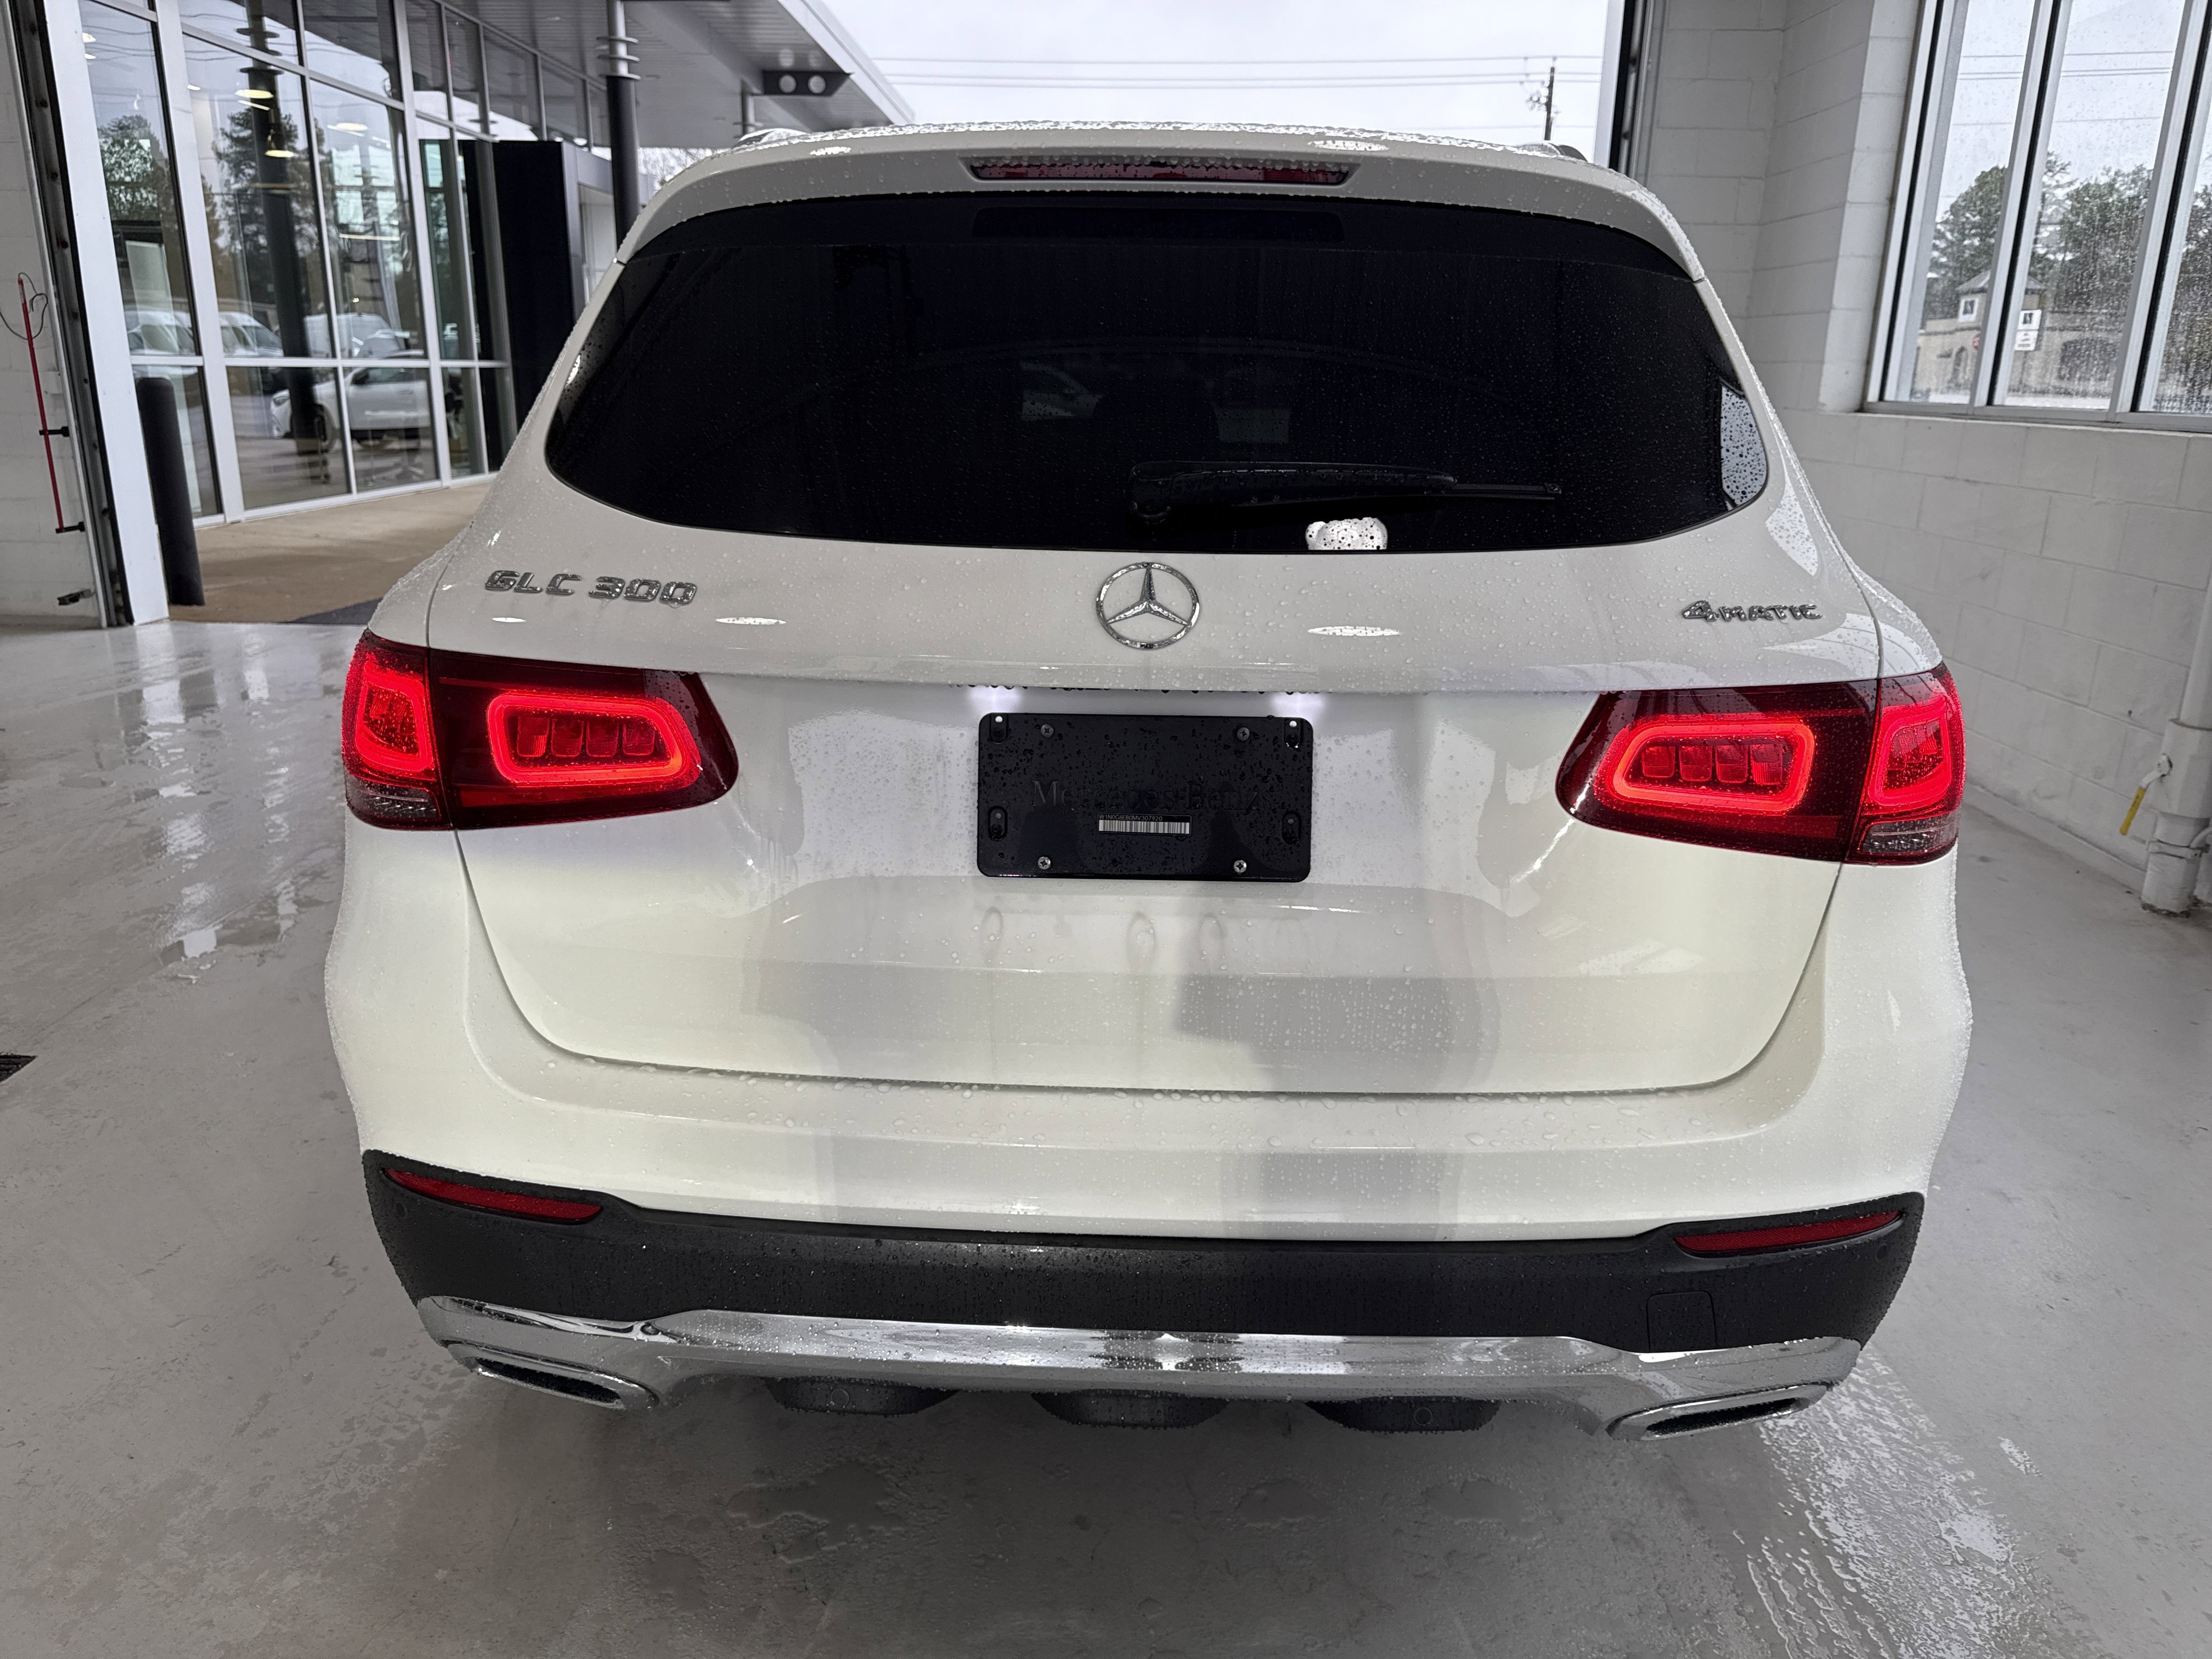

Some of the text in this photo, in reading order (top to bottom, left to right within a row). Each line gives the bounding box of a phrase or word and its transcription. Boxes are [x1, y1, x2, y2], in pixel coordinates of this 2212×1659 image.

[485, 570, 697, 604] GLC 300
[1681, 600, 1822, 621] 4MATIC
[1099, 814, 1163, 822] W1N0G8EB0MV307920
